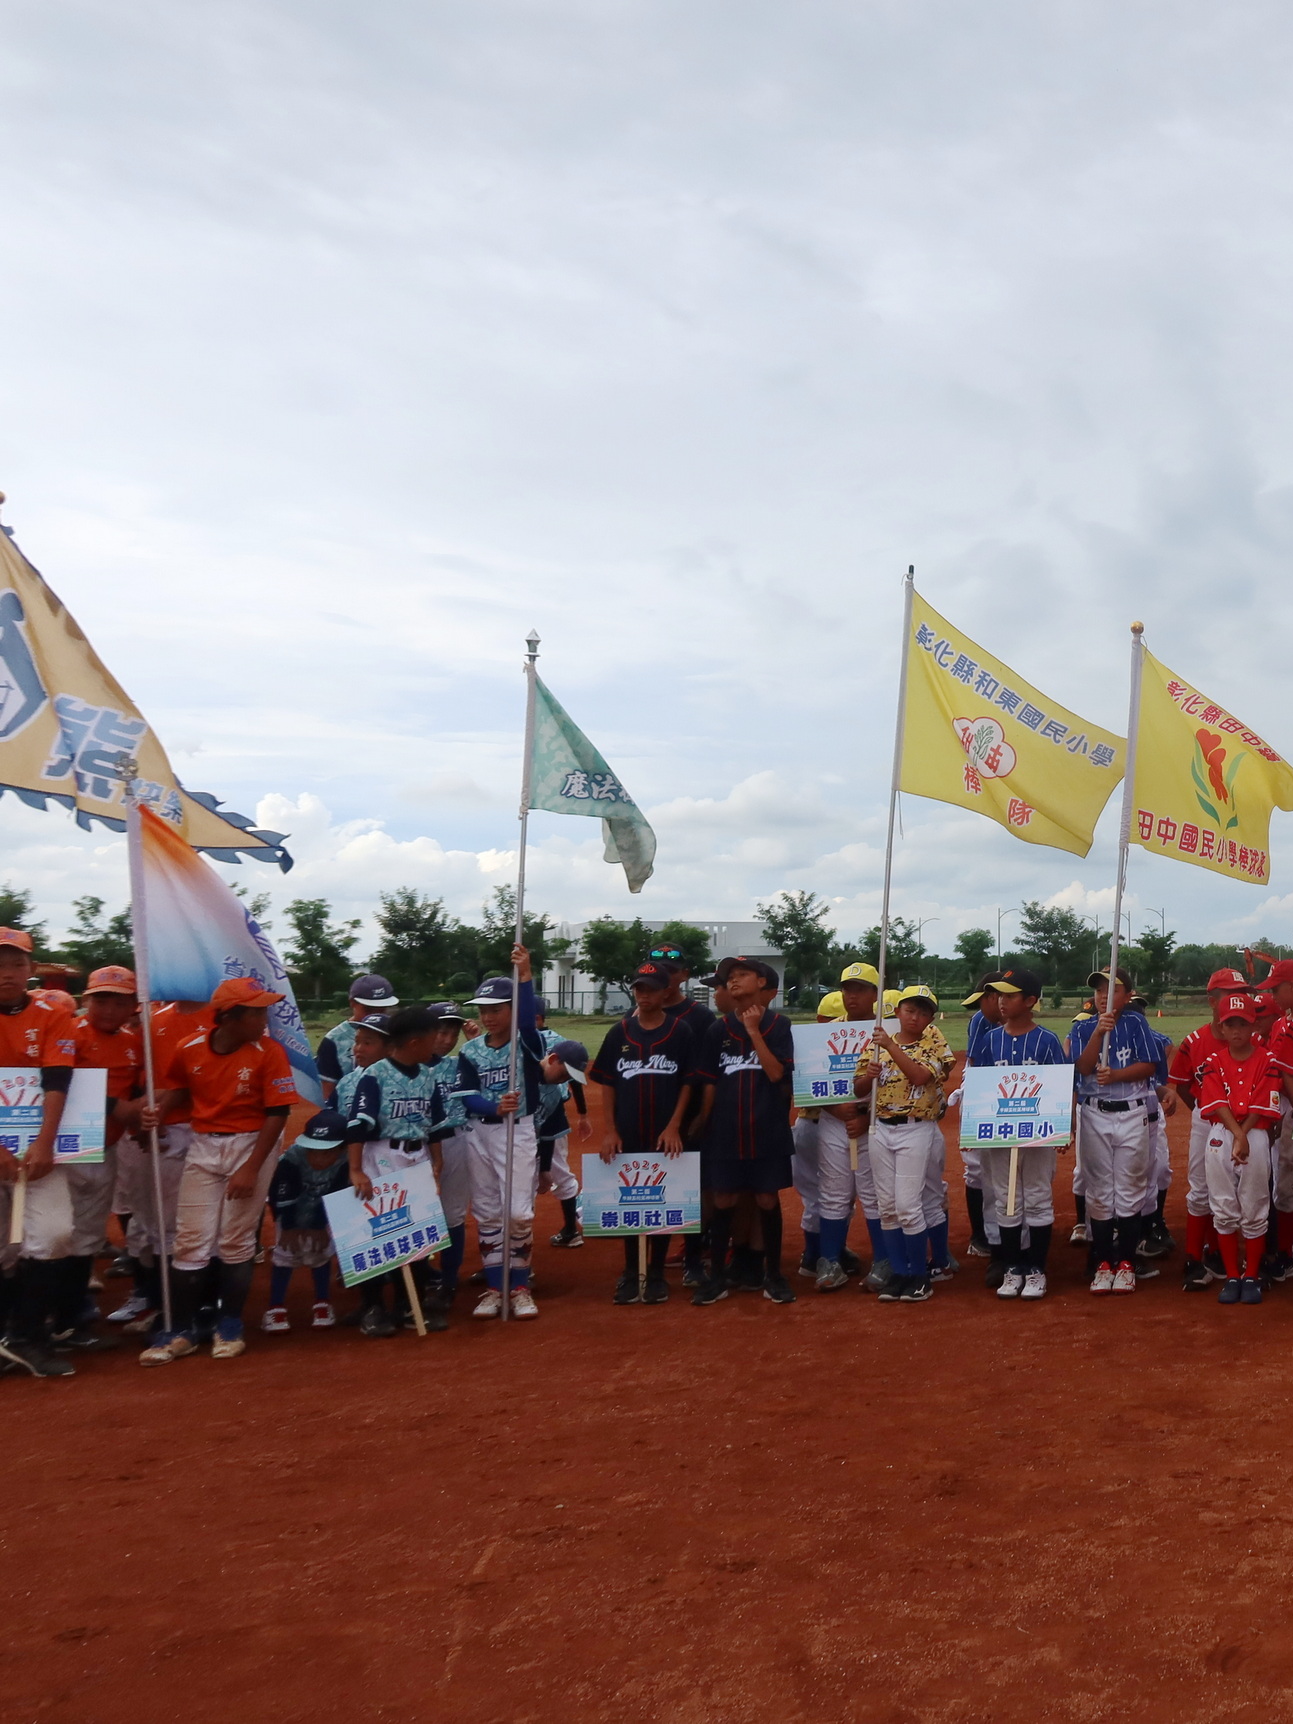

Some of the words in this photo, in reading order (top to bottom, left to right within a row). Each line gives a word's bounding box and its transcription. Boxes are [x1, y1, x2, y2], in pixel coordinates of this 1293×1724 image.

[914, 623, 1116, 768] 彰化縣和東國民小學
[848, 965, 862, 976] D
[918, 986, 931, 998] D
[883, 1002, 895, 1015] D
[830, 1028, 867, 1042] 2024
[3, 1075, 40, 1091] 202
[1001, 1072, 1037, 1085] 2024
[811, 1079, 849, 1098] 和東
[977, 1121, 1054, 1140] 田中國小
[373, 1182, 401, 1195] 024
[601, 1209, 684, 1228] 崇明社區
[352, 1225, 440, 1272] 魔法棒球學院
